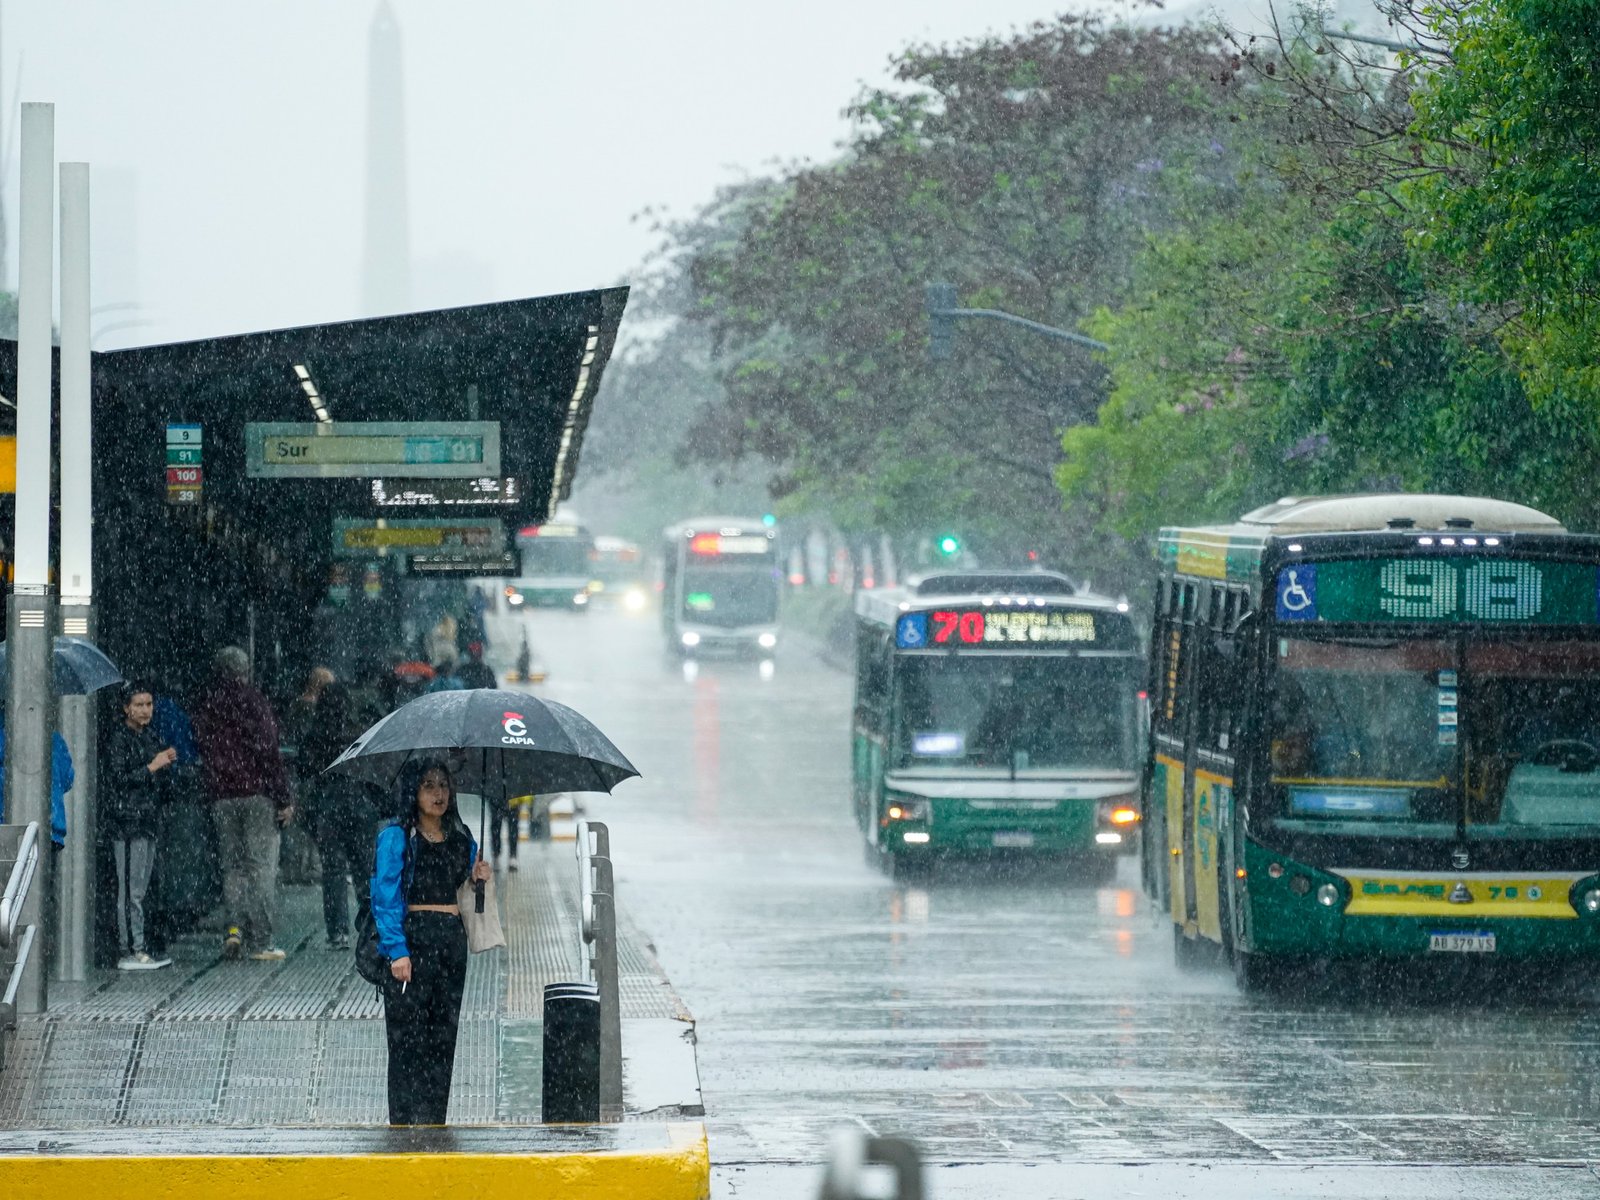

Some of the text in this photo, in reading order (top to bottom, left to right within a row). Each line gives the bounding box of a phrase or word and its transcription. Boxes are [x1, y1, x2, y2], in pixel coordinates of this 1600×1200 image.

[182, 430, 189, 441] 9
[179, 450, 192, 461] 91
[278, 441, 309, 457] Sur
[452, 442, 477, 461] 91
[177, 470, 197, 481] 100
[179, 490, 194, 501] 39
[1380, 560, 1542, 619] 98
[933, 612, 985, 643] 70
[501, 736, 535, 746] CAPIA
[1452, 937, 1474, 951] 379
[1478, 938, 1494, 951] VS
